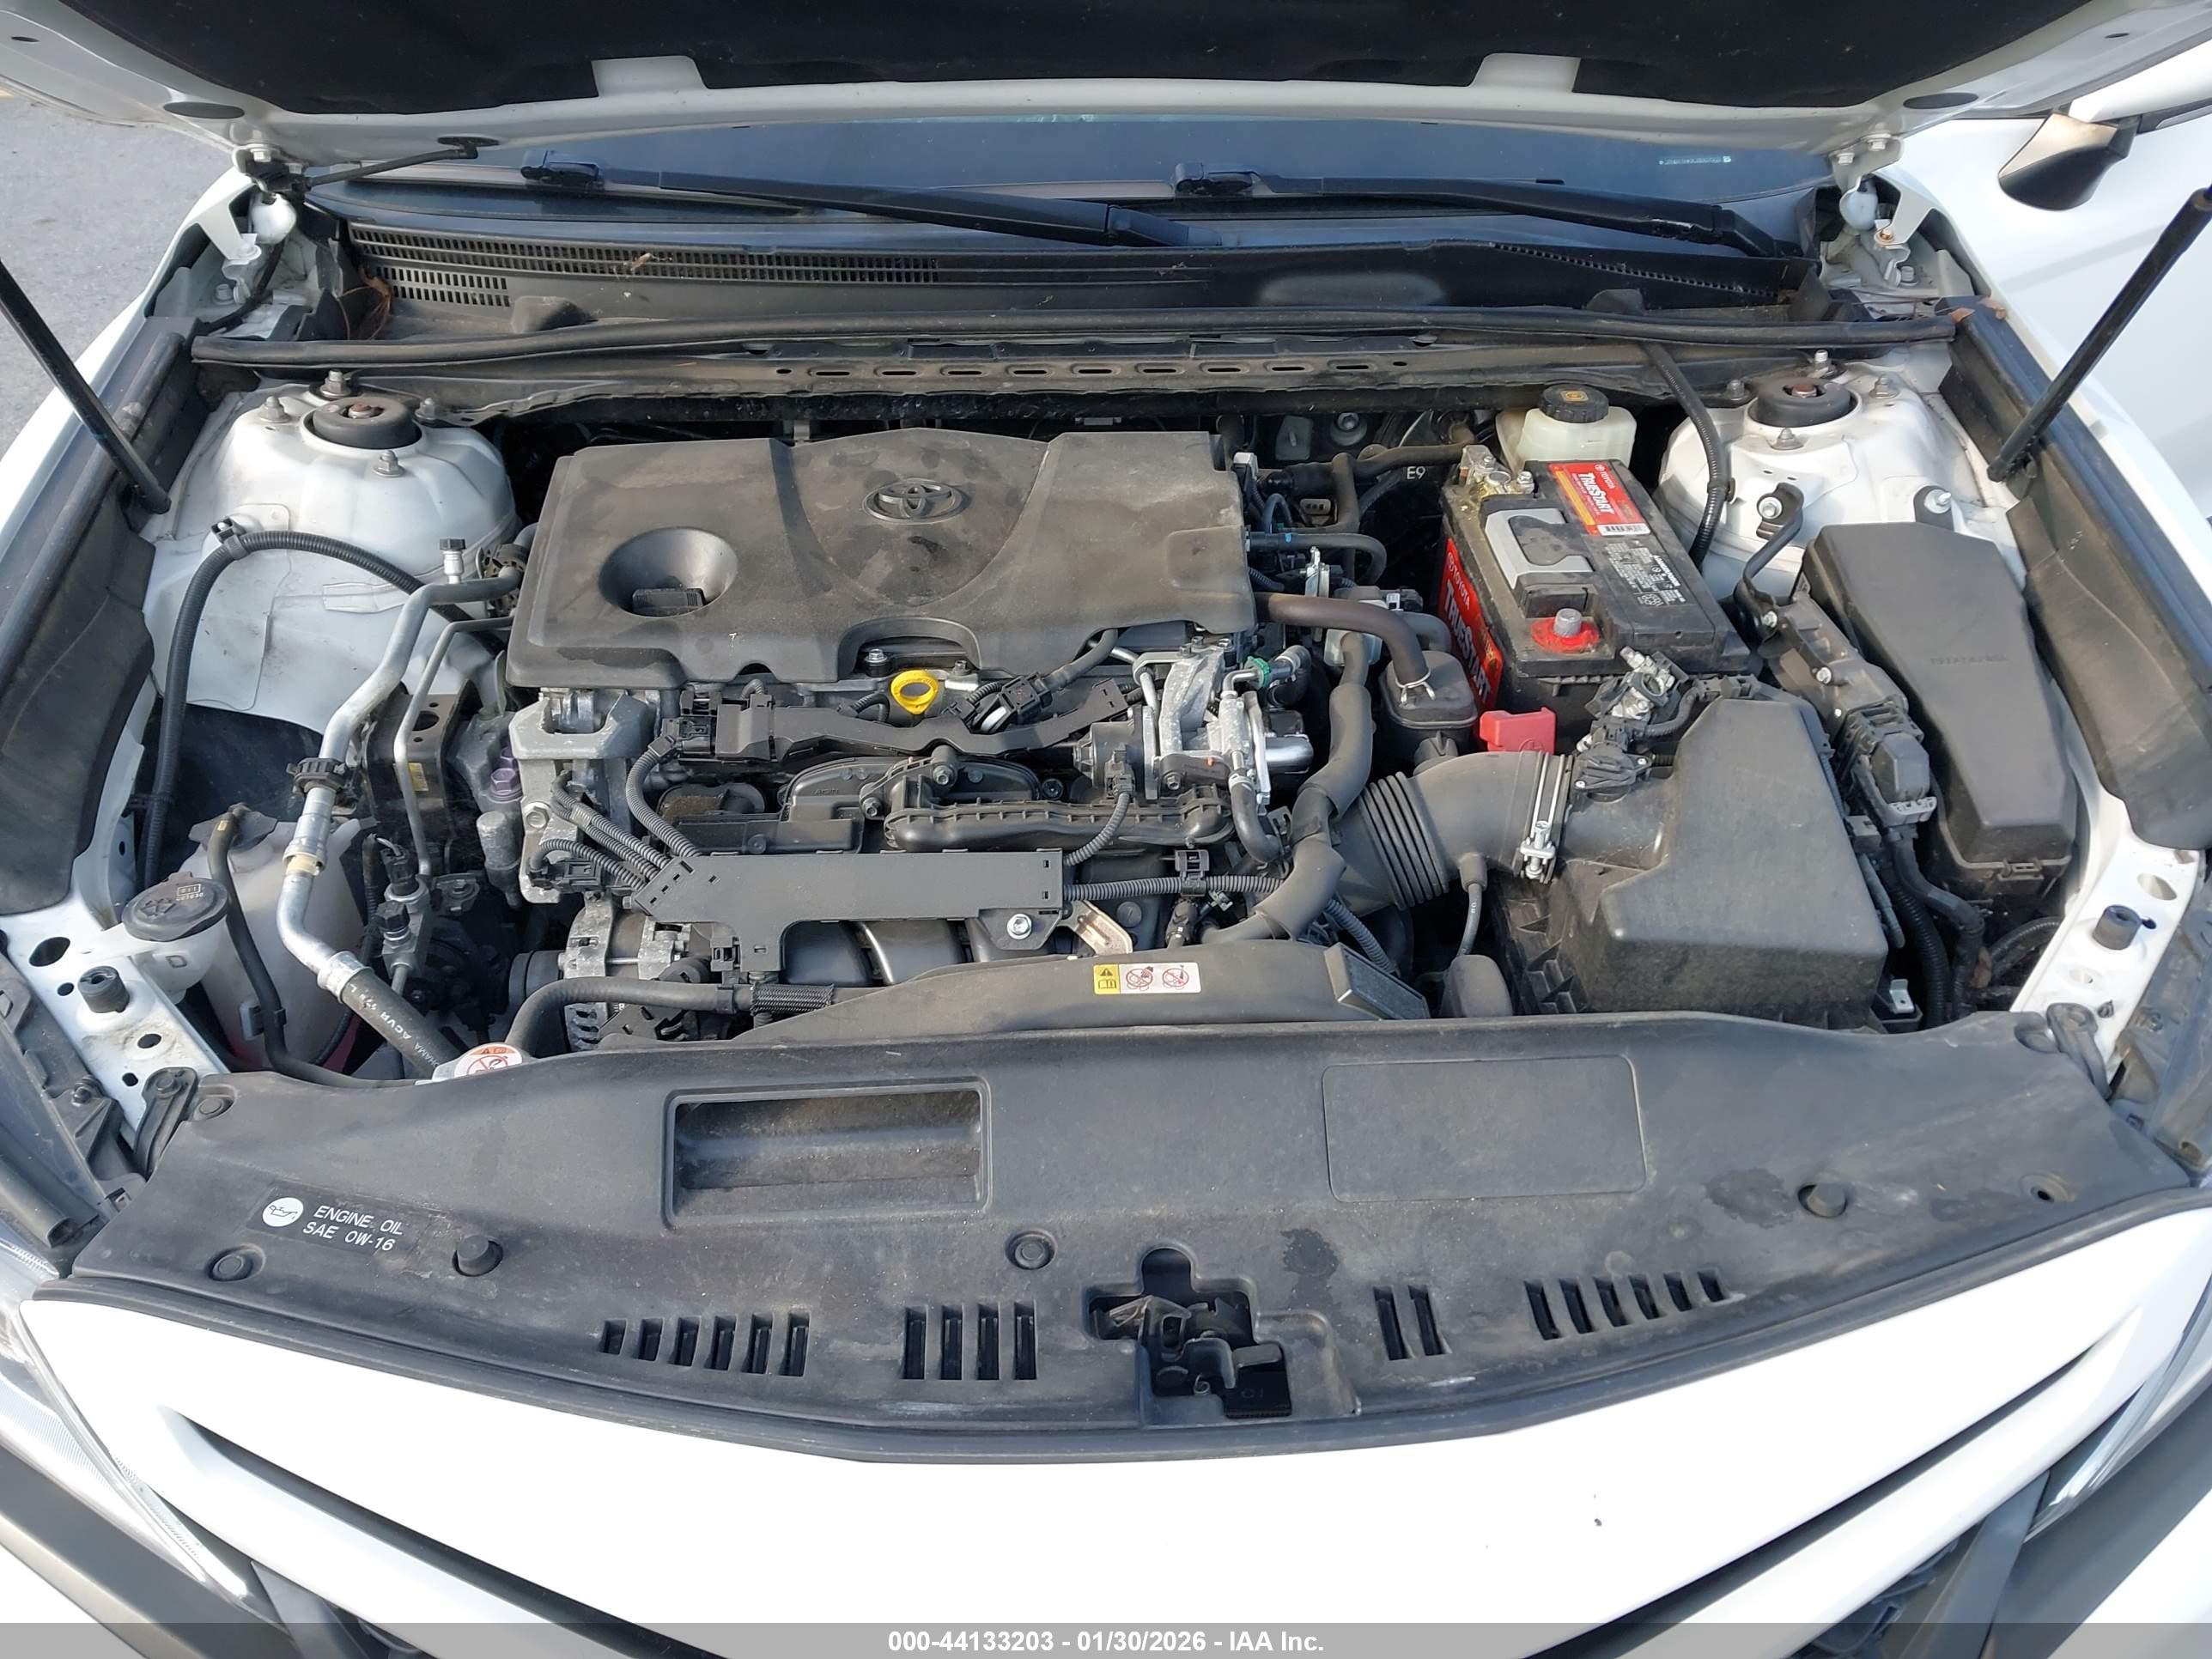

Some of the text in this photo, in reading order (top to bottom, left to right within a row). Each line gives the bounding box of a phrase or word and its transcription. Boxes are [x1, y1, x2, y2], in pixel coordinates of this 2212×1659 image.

[1407, 465, 1426, 480] E9
[1601, 471, 1615, 489] TOYOTA
[1449, 563, 1471, 611] TOYOTA
[313, 1205, 404, 1236] ENGINE OIL
[302, 1221, 396, 1251] SAE 0W-16
